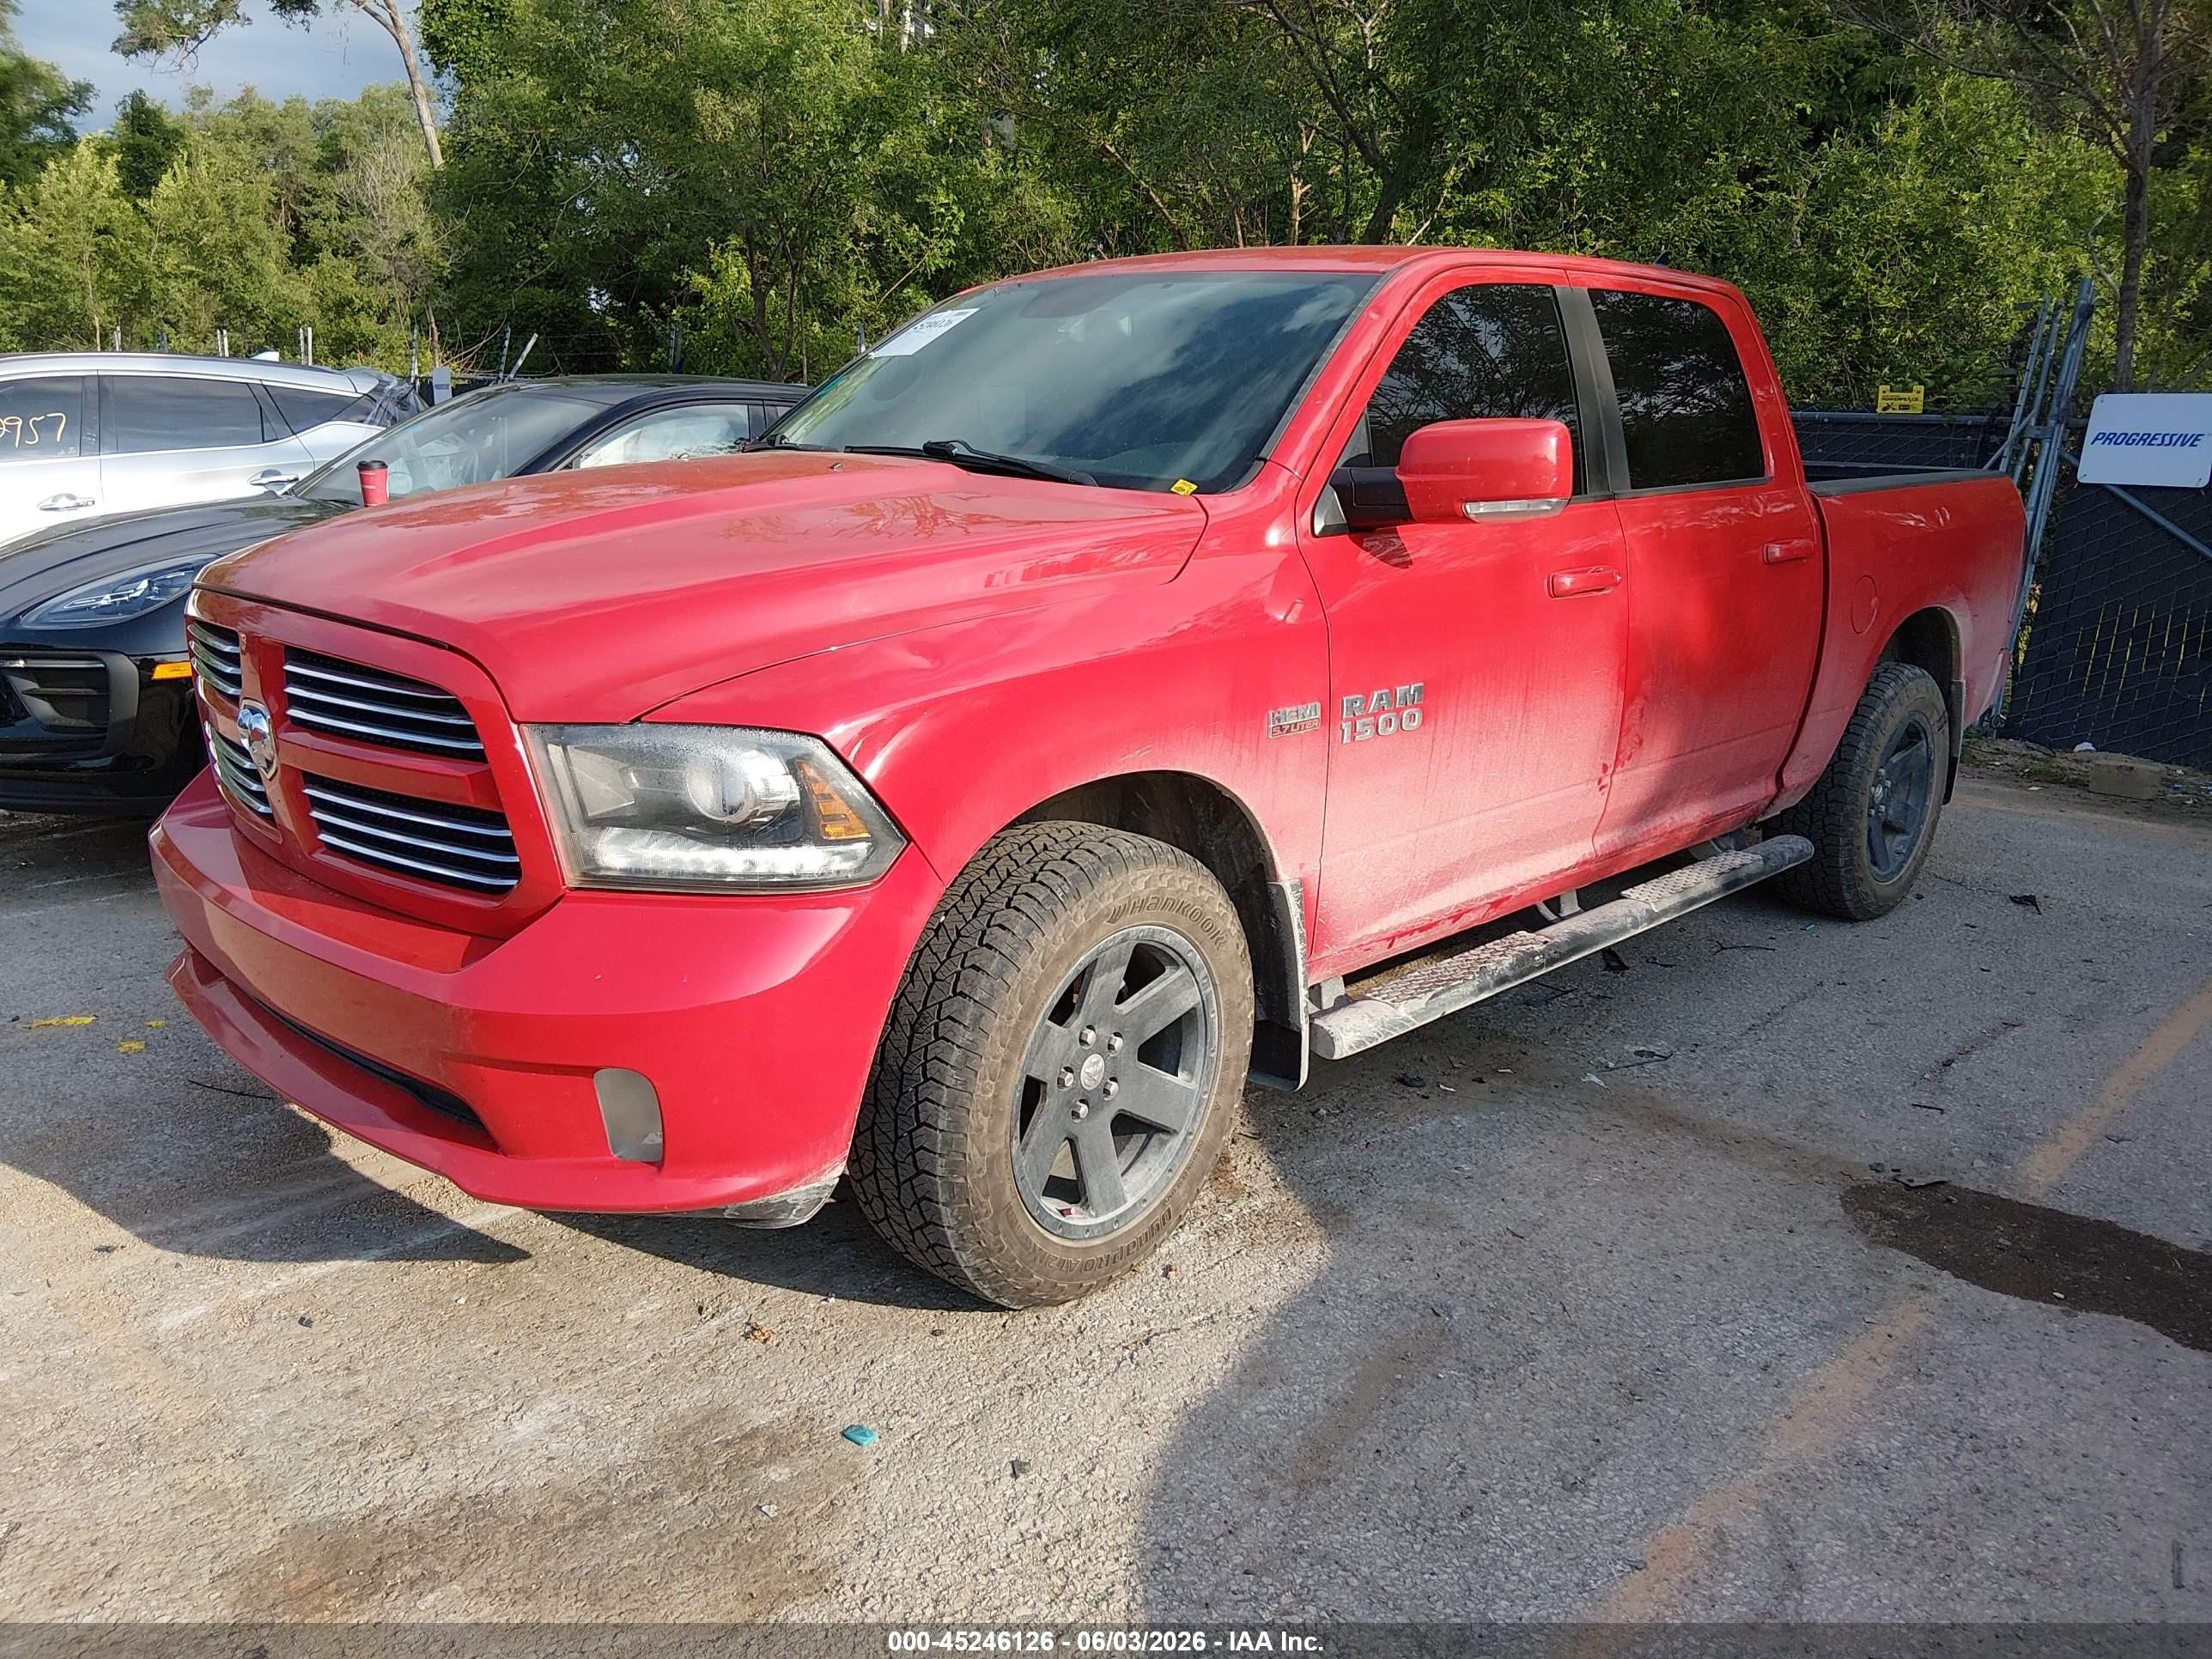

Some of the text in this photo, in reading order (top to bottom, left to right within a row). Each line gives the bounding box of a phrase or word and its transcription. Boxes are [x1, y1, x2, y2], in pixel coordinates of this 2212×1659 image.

[2090, 432, 2205, 447] PROGRESSIVE
[1341, 683, 1425, 719] RAM
[1270, 702, 1321, 726] HEMI
[1340, 708, 1424, 744] 1500
[1272, 718, 1320, 737] 5.7 LITER
